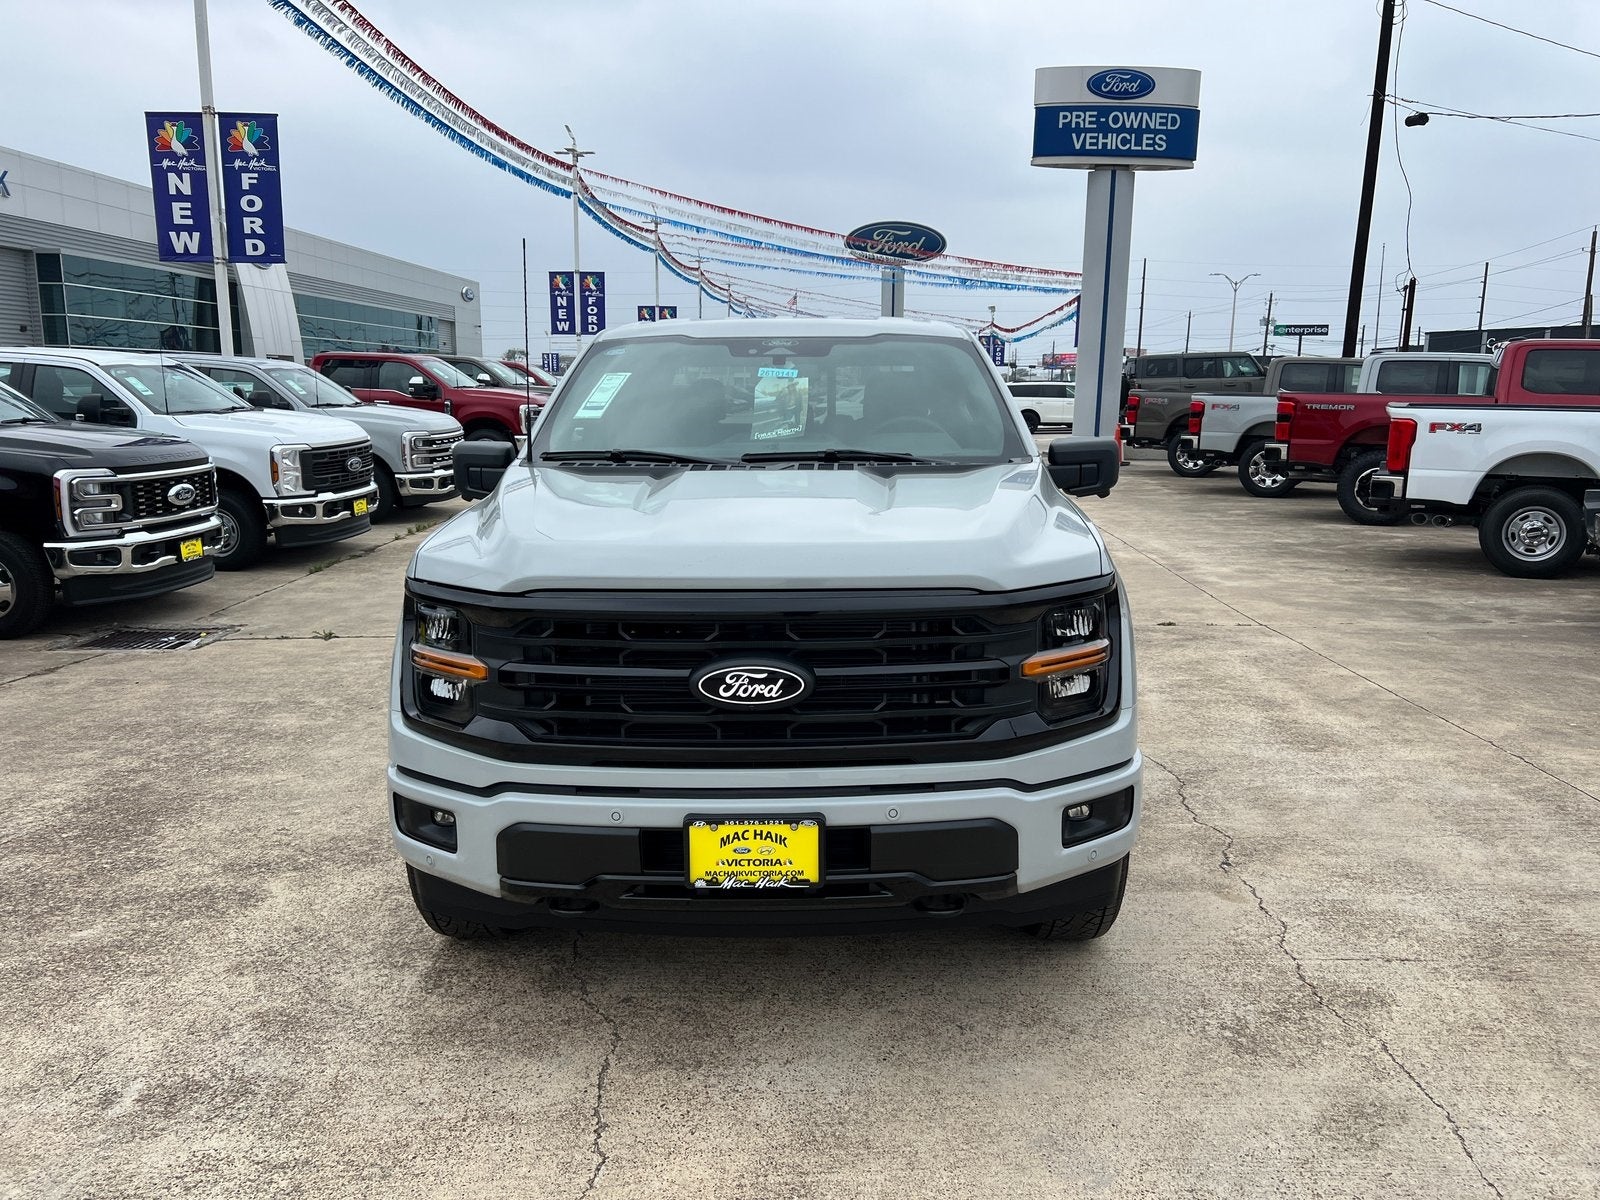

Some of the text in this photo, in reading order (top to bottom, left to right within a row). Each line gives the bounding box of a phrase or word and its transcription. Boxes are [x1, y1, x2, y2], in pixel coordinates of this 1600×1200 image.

[1101, 74, 1140, 92] Ford
[1072, 133, 1167, 151] VEHICLES
[167, 172, 200, 254] NEW
[240, 172, 265, 256] FORD
[556, 296, 570, 331] NEW
[587, 296, 598, 333] FORD
[1278, 326, 1328, 335] enterprise
[1305, 403, 1356, 411] TREMOR
[1429, 422, 1483, 433] FX4
[719, 671, 784, 698] Ford
[720, 829, 788, 849] MAC HAIK
[725, 858, 783, 867] VICTORIA
[720, 875, 790, 889] Mac Haik
